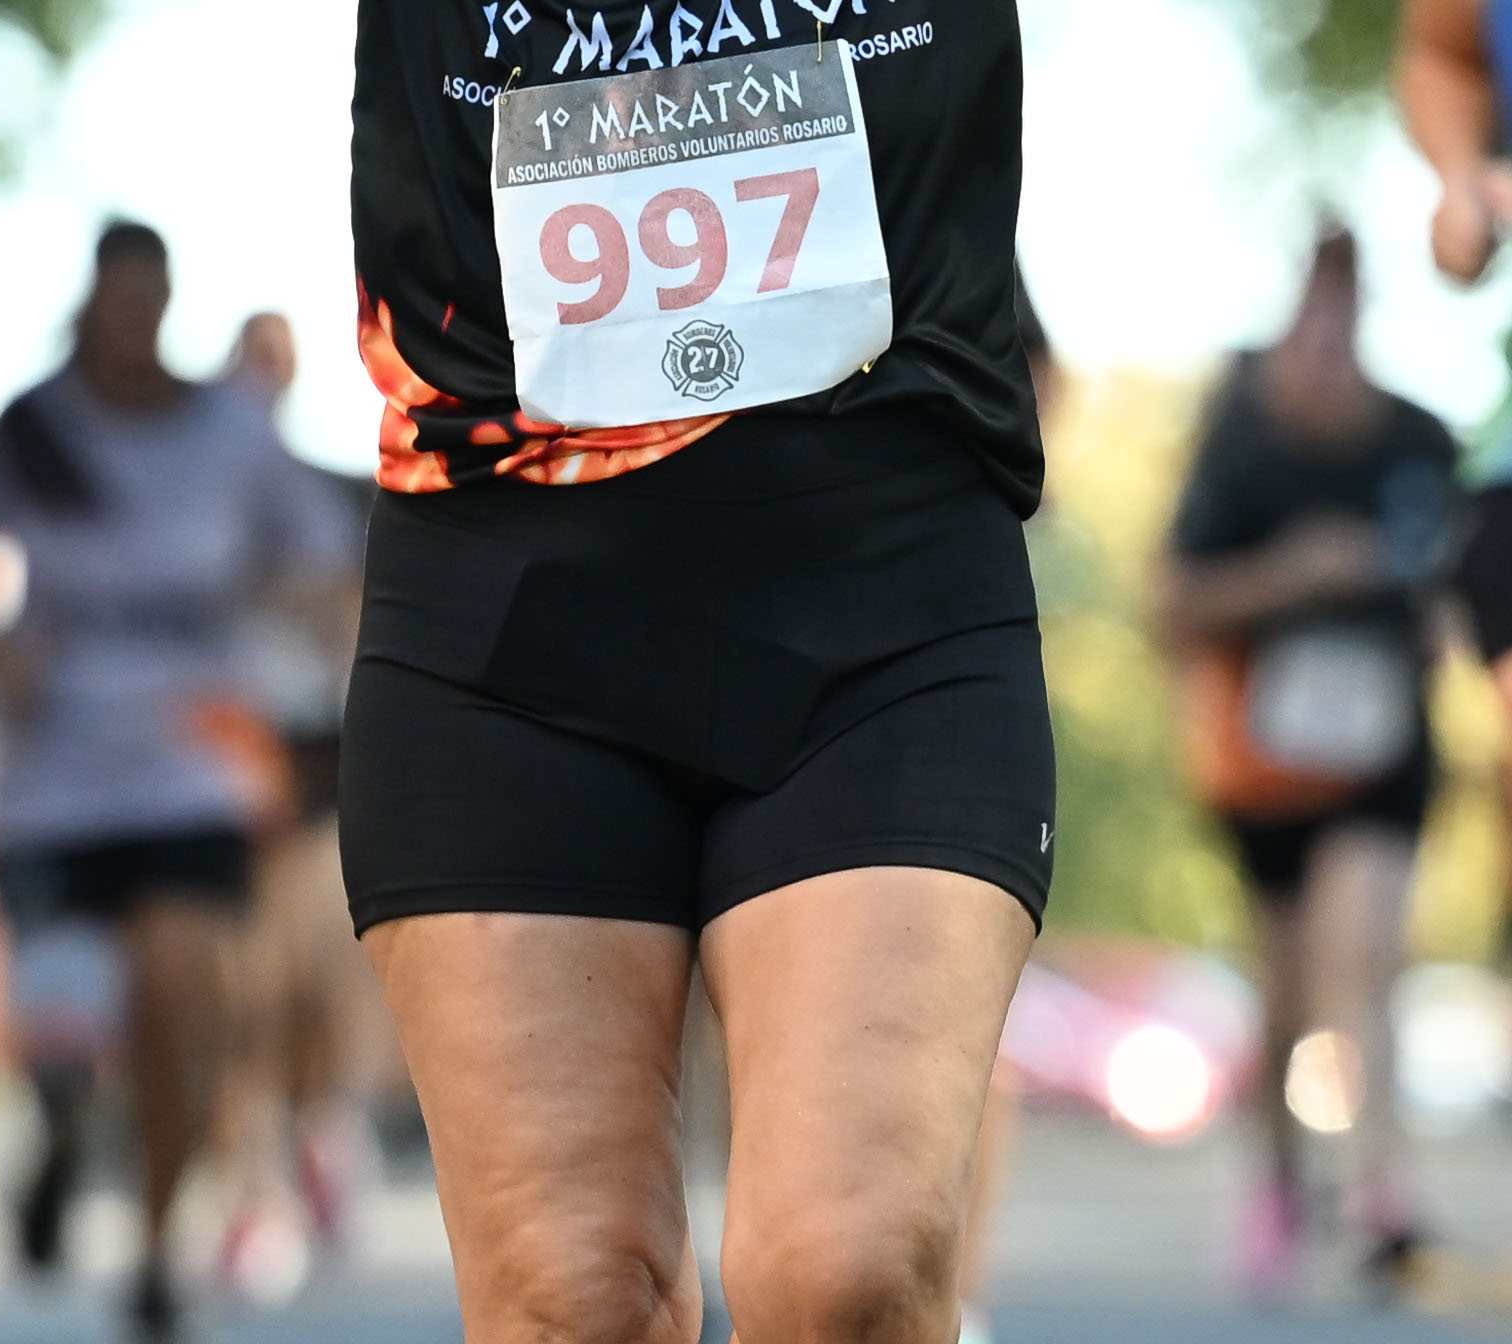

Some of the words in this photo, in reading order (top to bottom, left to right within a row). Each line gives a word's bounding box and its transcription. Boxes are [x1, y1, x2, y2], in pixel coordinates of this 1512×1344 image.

[848, 20, 934, 64] ROSARIO
[589, 63, 803, 145] MARATÓN
[507, 153, 594, 185] ASOCIACIÓN
[596, 142, 678, 172] BOMBEROS
[680, 125, 780, 159] VOLUNTARIOS
[782, 114, 848, 142] ROSARIO
[538, 166, 821, 326] 997
[687, 344, 719, 375] 27
